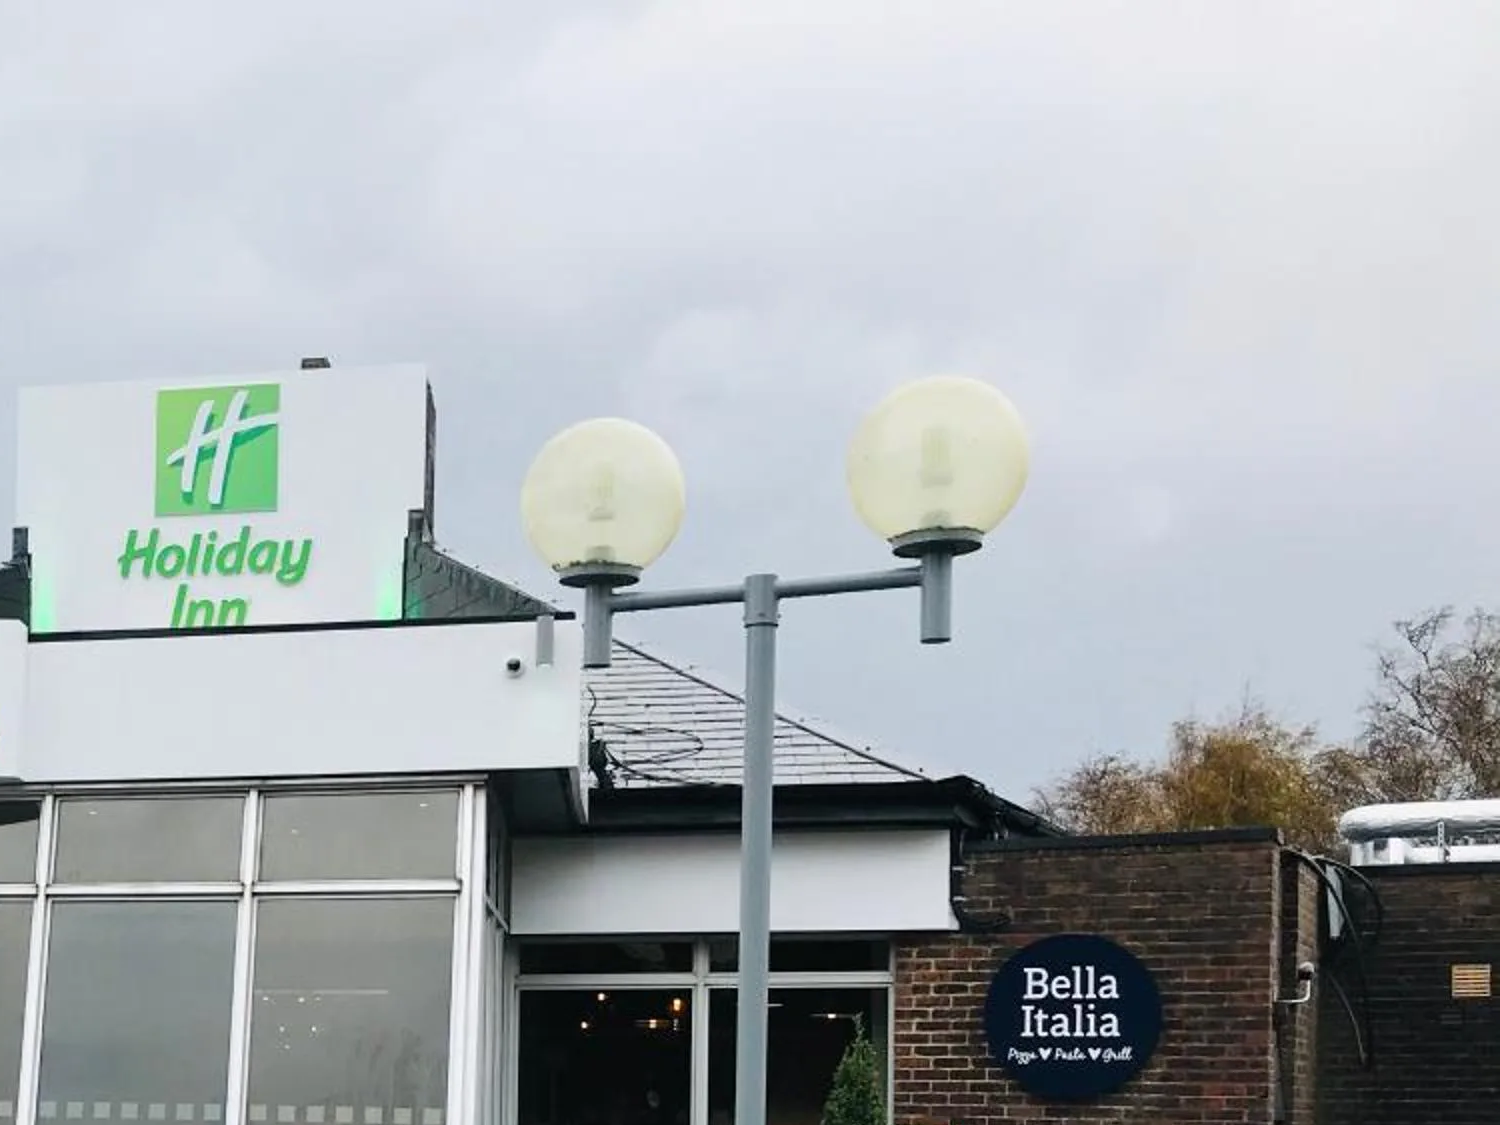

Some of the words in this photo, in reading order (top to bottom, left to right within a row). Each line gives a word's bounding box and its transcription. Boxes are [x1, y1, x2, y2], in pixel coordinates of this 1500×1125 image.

[117, 525, 313, 586] Holiday
[170, 583, 251, 629] Inn
[1022, 965, 1120, 1000] Bella
[1020, 1003, 1121, 1037] Italia
